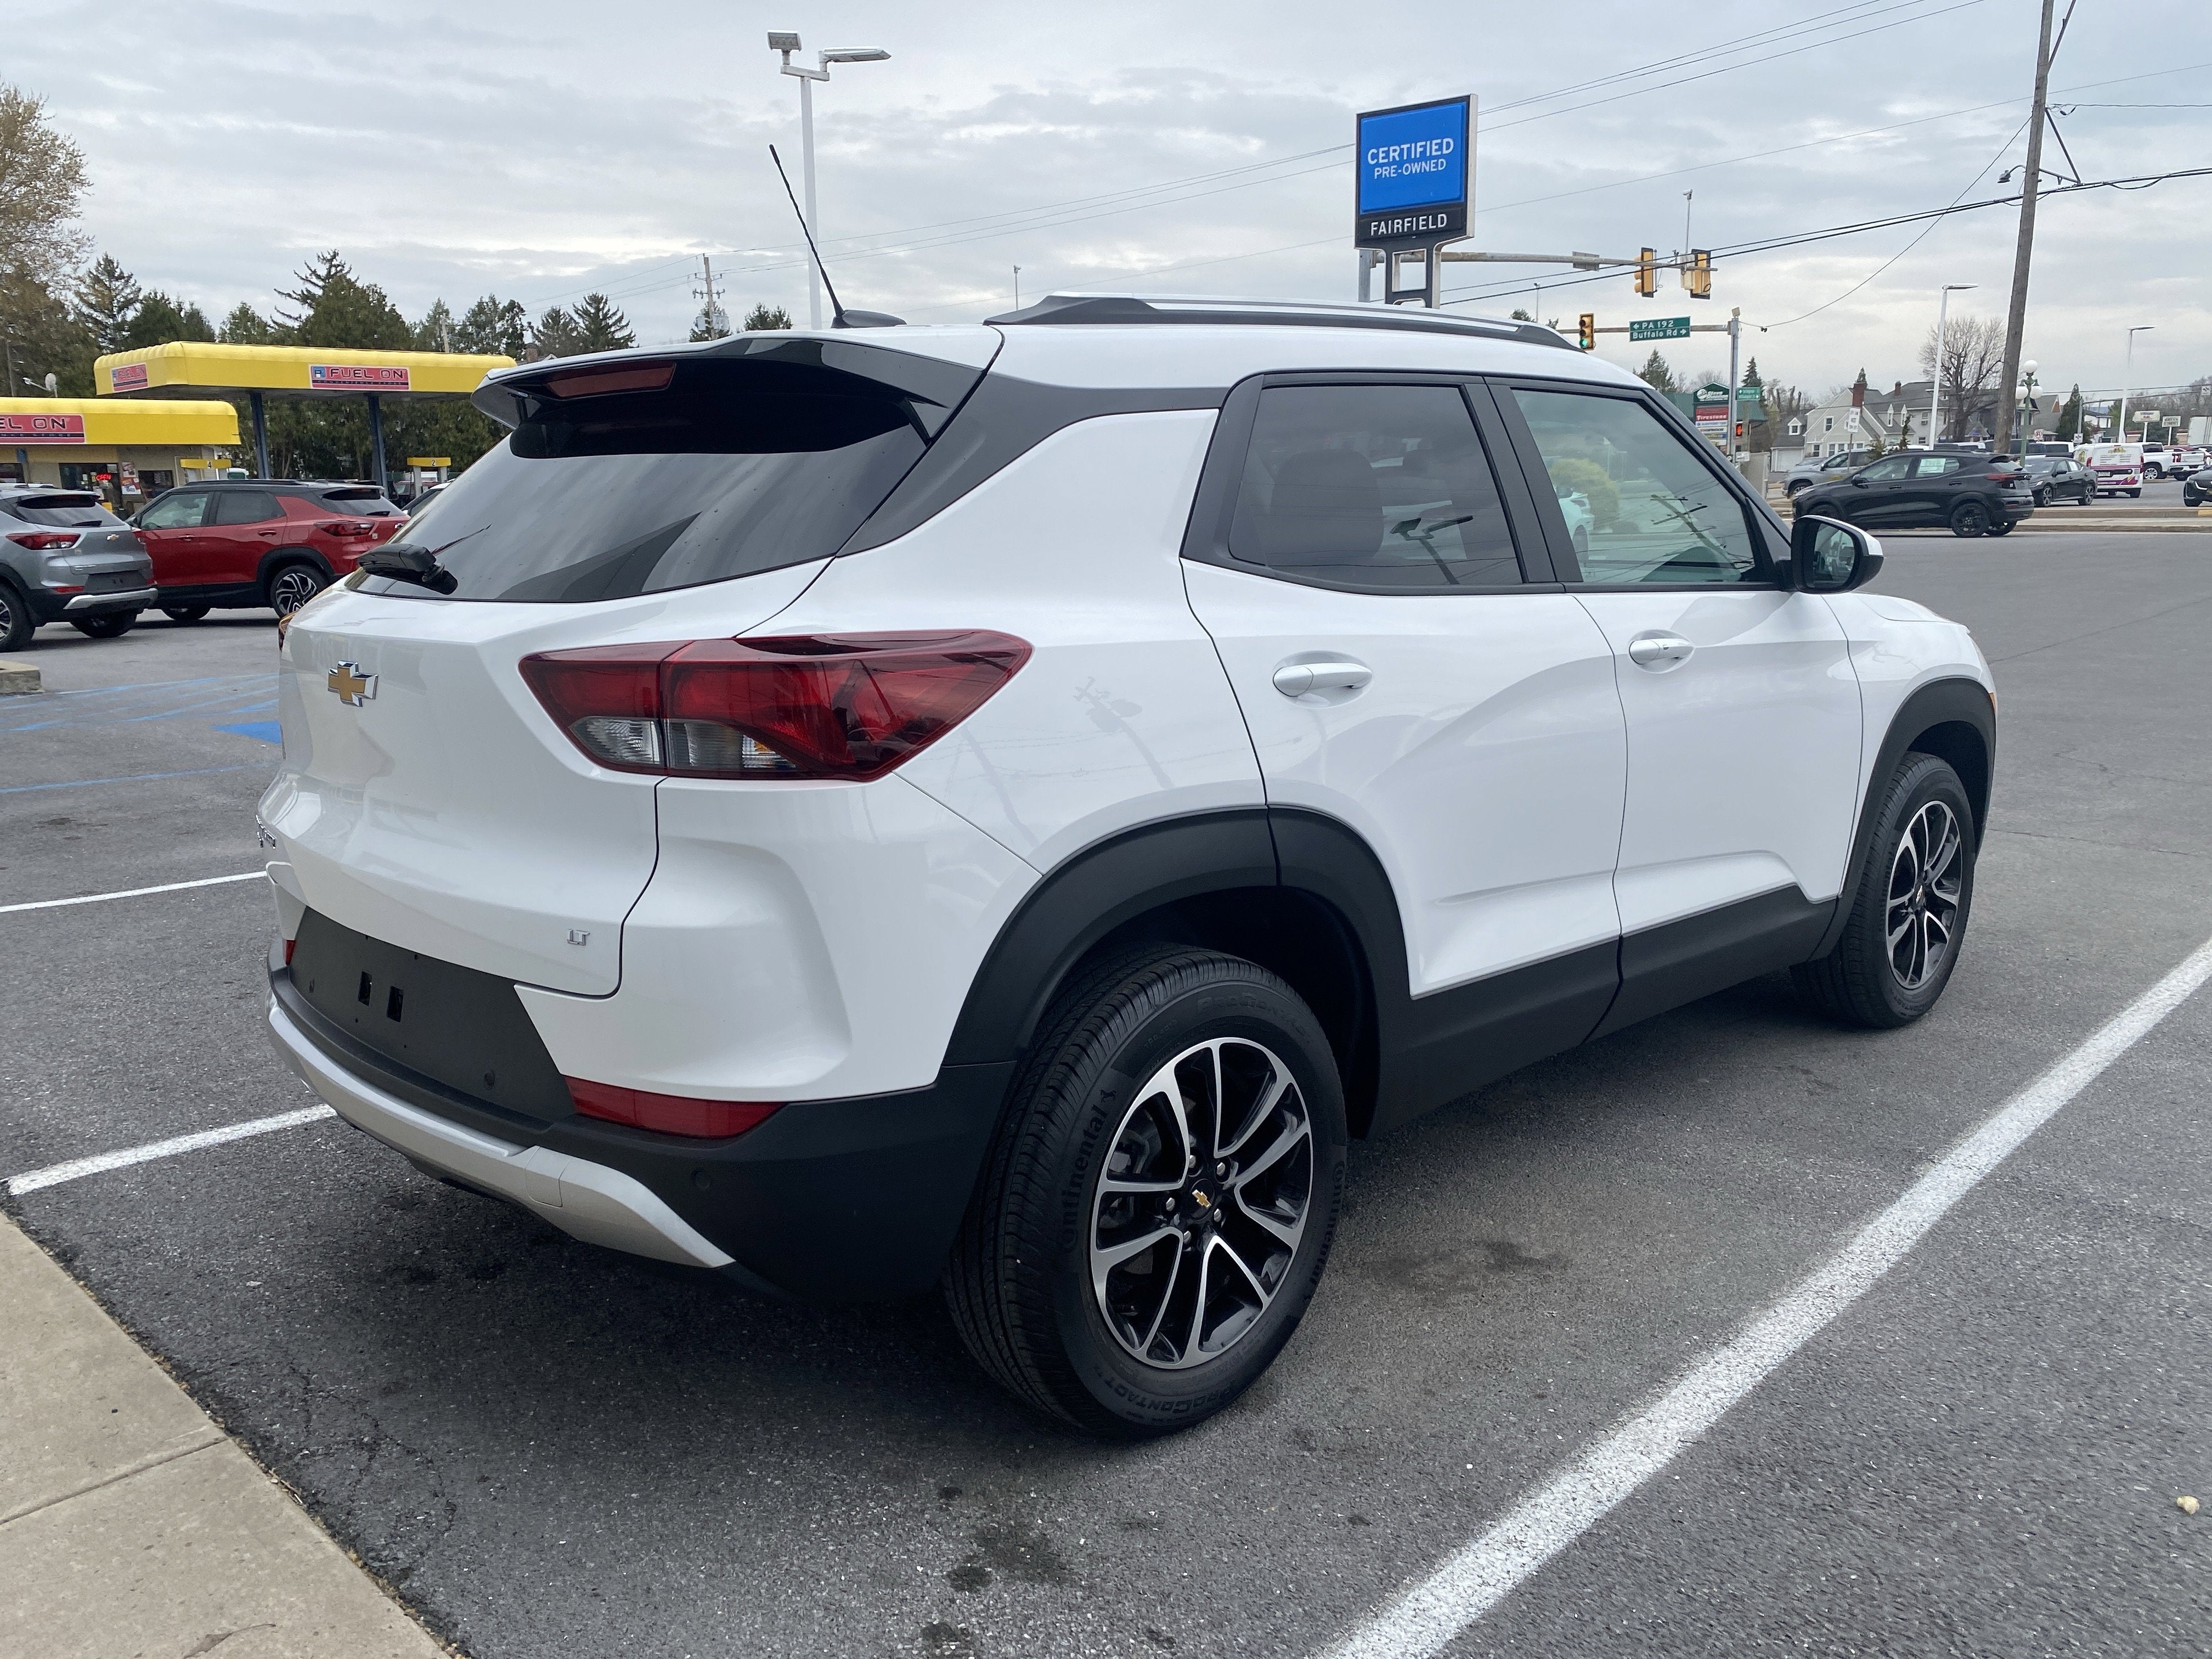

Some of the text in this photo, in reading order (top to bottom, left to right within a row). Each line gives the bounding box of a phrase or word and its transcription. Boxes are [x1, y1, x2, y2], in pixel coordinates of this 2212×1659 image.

[1367, 137, 1454, 165] CERTIFIED
[1374, 158, 1447, 179] PRE-OWNED
[1370, 213, 1448, 236] FAIRFIELD
[1657, 320, 1674, 328] 192
[1633, 330, 1664, 339] Buffalo
[330, 368, 404, 379] FUEL ON
[33, 418, 66, 429] ON
[208, 461, 212, 469] 4
[567, 929, 590, 946] LT
[1061, 1104, 1109, 1253] Continental
